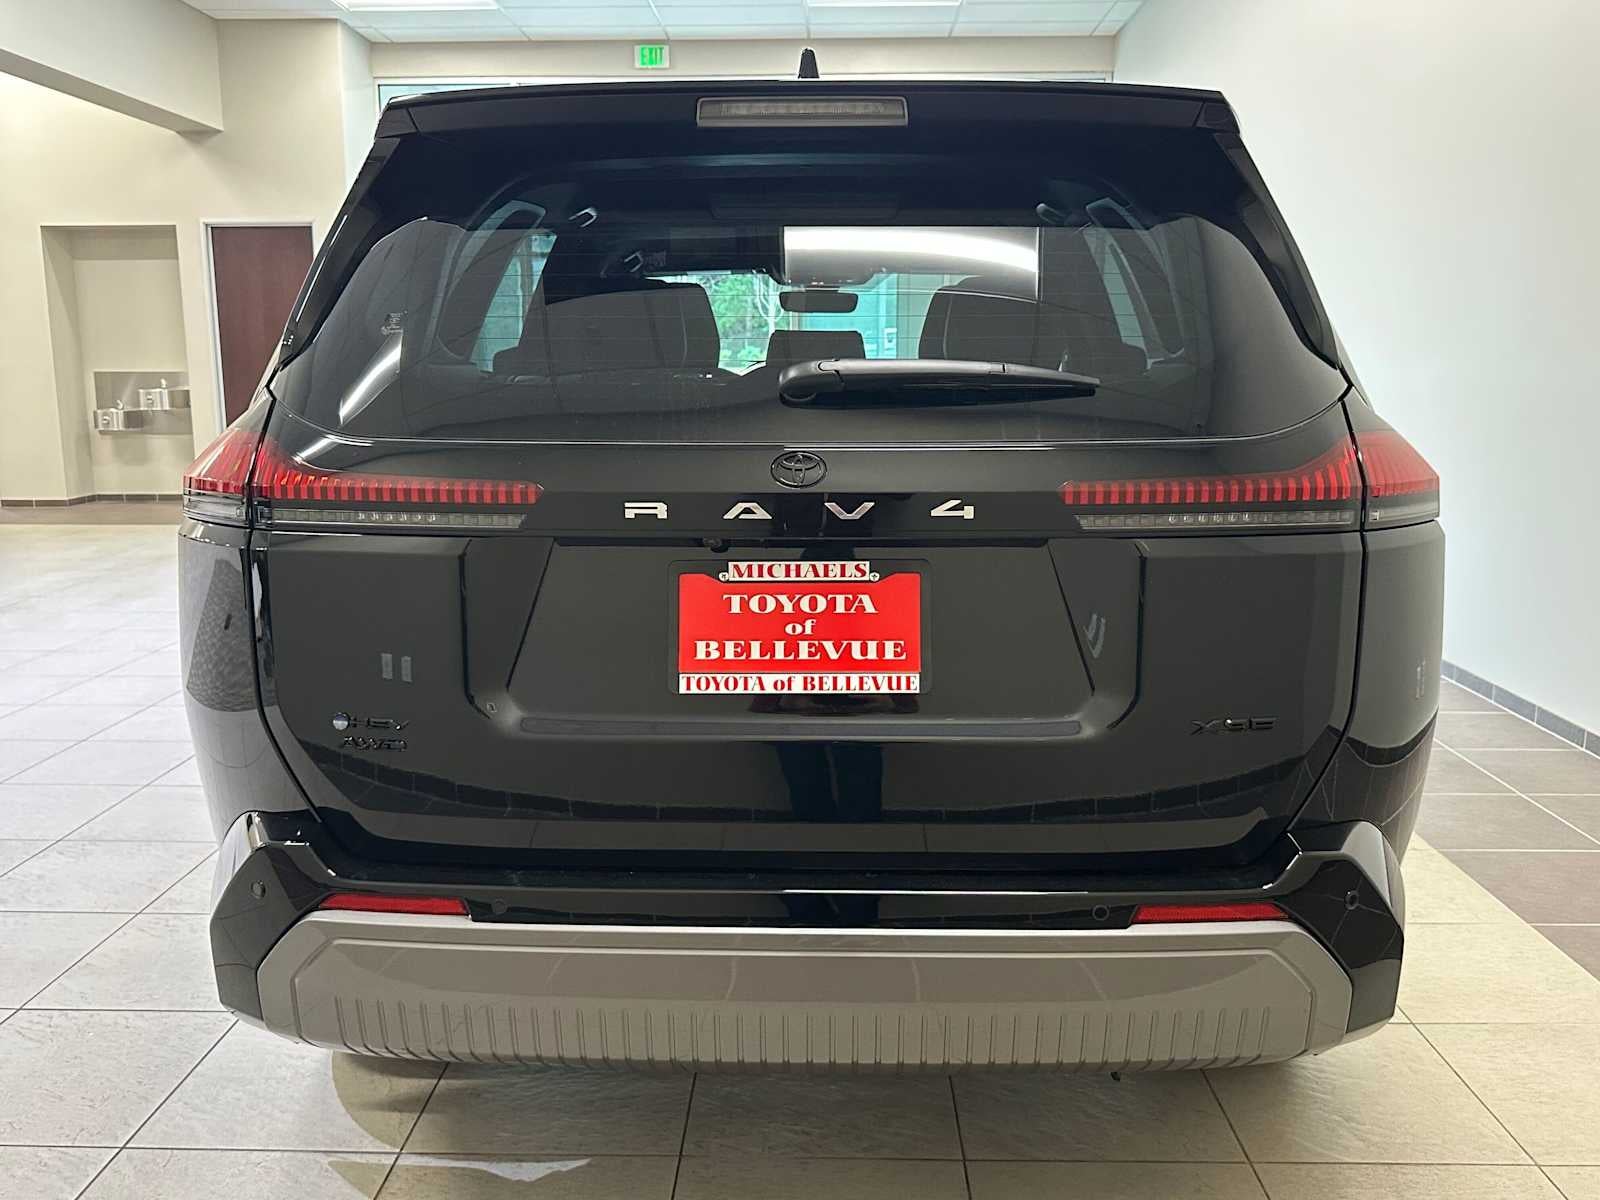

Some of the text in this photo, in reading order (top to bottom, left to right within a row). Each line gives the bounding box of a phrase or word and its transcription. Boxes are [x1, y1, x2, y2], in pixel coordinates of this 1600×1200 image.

[641, 46, 665, 66] EXIT
[731, 563, 868, 579] MICHAELS
[723, 594, 878, 614] TOYOTA
[784, 619, 816, 635] of
[694, 640, 907, 661] BELLEVUE
[681, 676, 918, 692] TOYOTA of BELLEVUE
[1191, 717, 1277, 735] XSE
